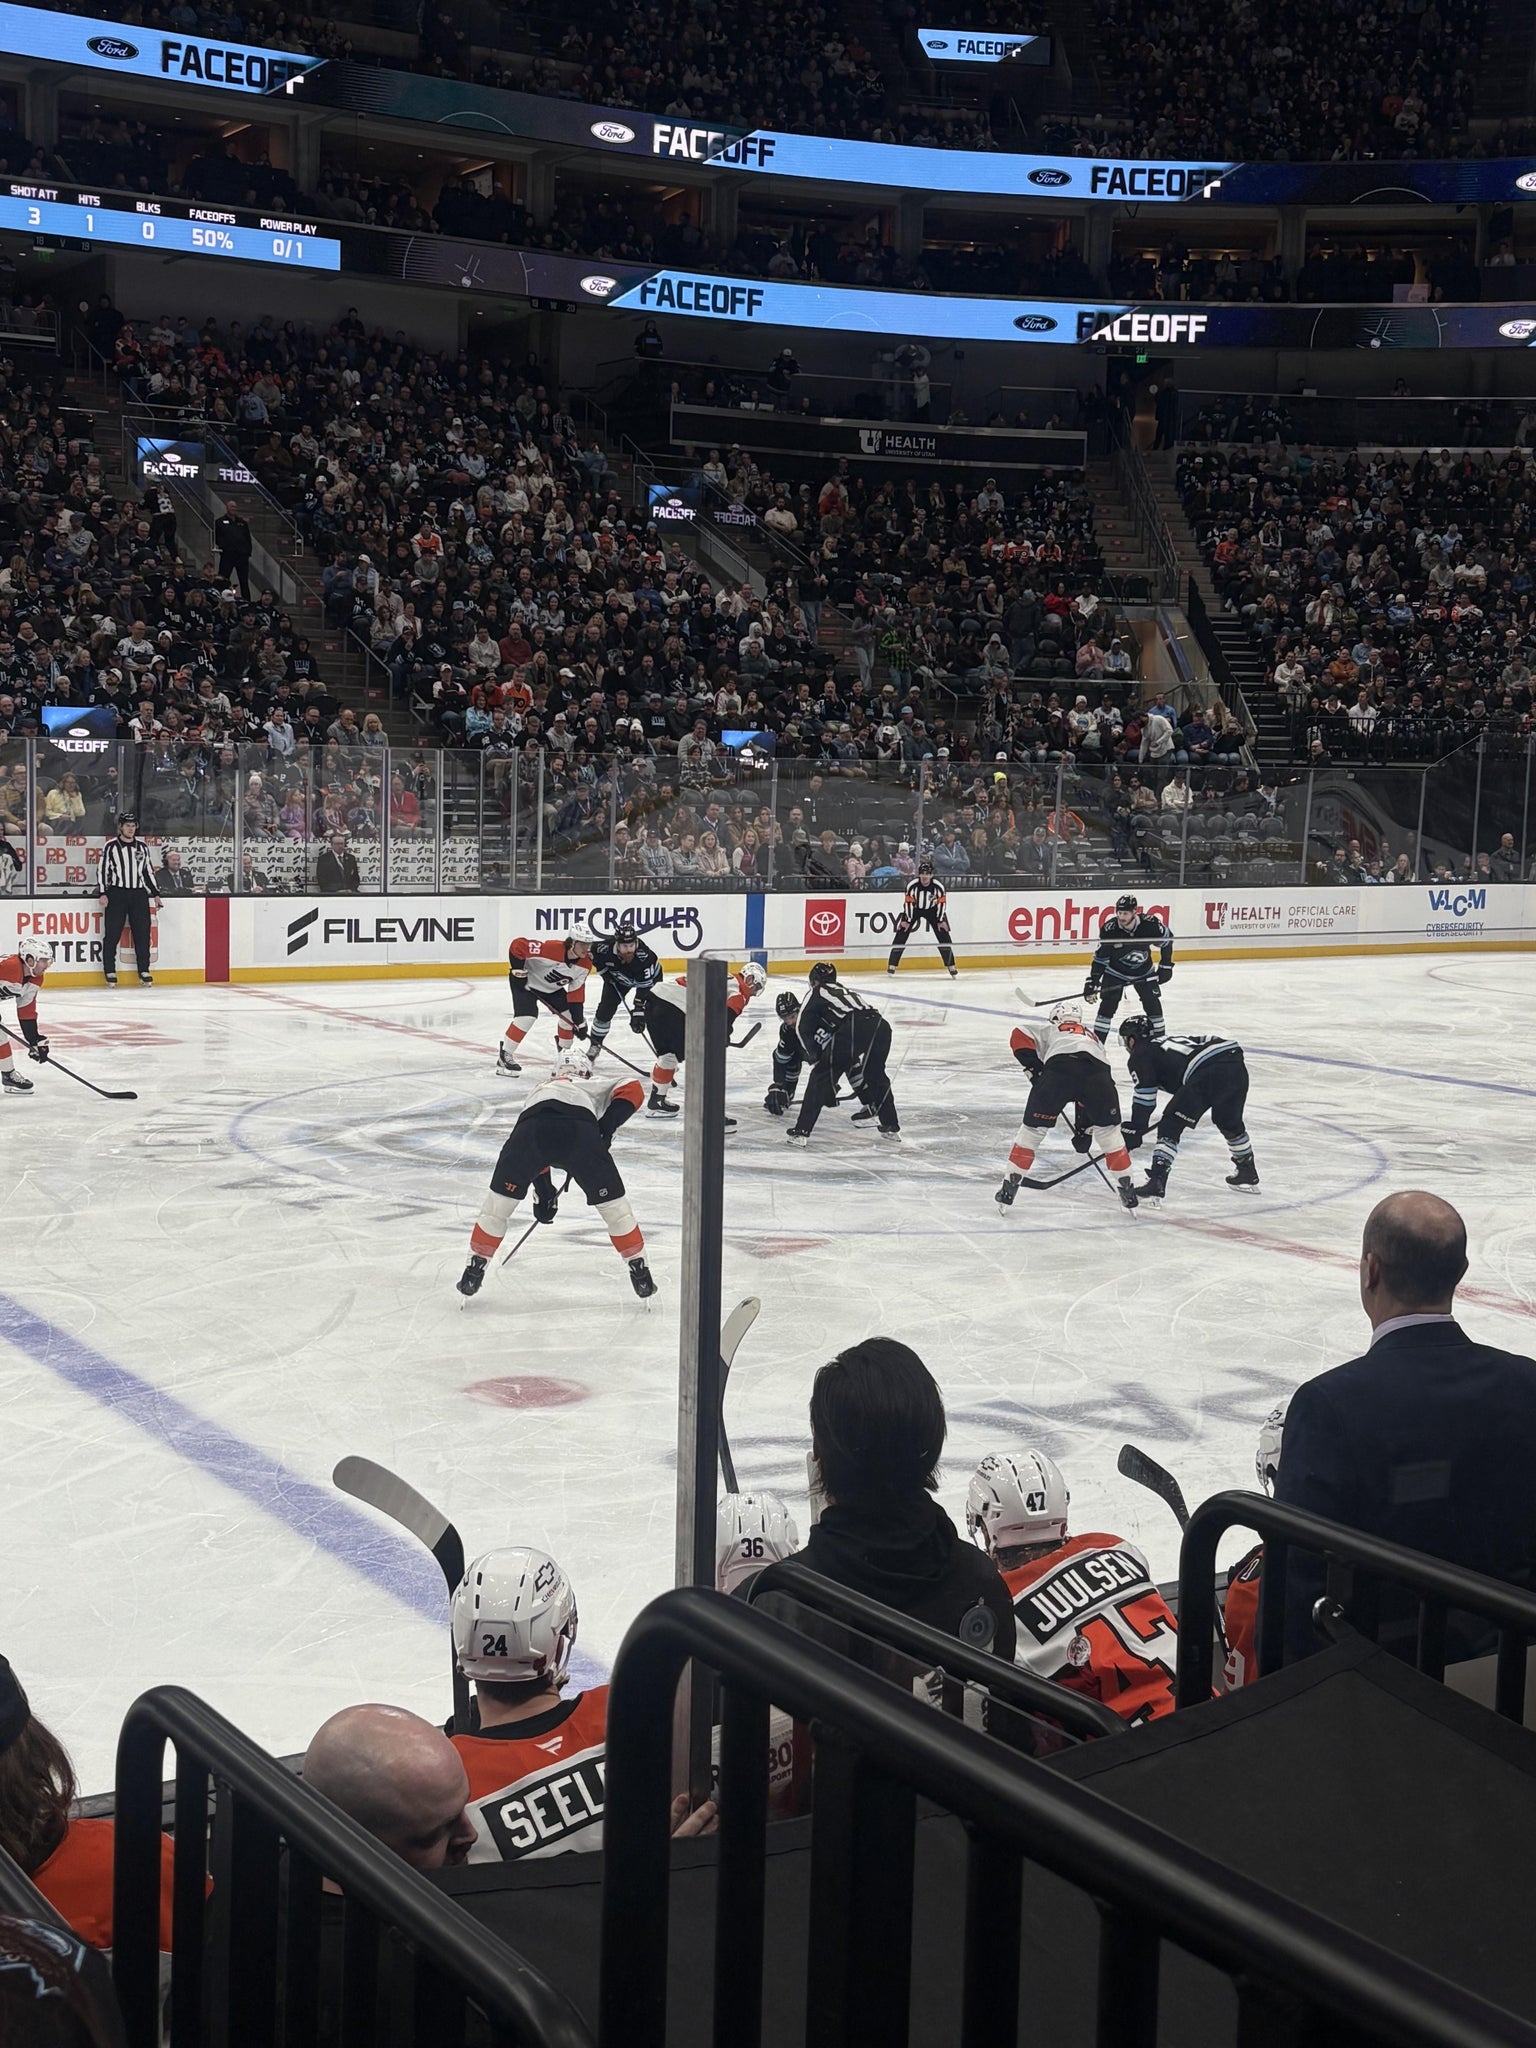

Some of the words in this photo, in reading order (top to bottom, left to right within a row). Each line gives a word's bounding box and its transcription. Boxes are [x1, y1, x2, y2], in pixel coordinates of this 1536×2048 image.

[957, 39, 1022, 57] FACEOFF
[94, 37, 133, 58] Ford
[161, 40, 306, 94] FACEOFF
[596, 122, 629, 142] Ford
[653, 123, 776, 167] FACEOFF
[1032, 169, 1067, 186] Ford
[1091, 166, 1223, 198] FACEOFF
[11, 185, 37, 198] SHOT
[38, 188, 58, 201] ATT
[78, 194, 100, 206] HITS
[28, 207, 41, 225] 3
[136, 202, 161, 215] BLKS
[189, 209, 236, 225] FACEOFFS
[86, 215, 94, 232] 1
[142, 222, 155, 239] 0
[260, 218, 293, 234] POWER
[293, 222, 317, 236] PLAY
[192, 228, 234, 250] 50%
[273, 239, 303, 259] 0/1
[640, 278, 764, 316] FACEOFF
[1018, 314, 1053, 332] Ford
[1076, 311, 1208, 342] FACEOFF
[885, 435, 936, 450] HEALTH
[653, 506, 696, 520] FACEOFF
[1231, 907, 1281, 920] HEALTH
[1288, 906, 1329, 917] OFFICIAL
[1332, 905, 1357, 915] CARE
[17, 912, 104, 935] PEANUT
[324, 917, 475, 943] FILEVINE
[855, 912, 951, 934] TOY
[1288, 918, 1334, 928] PROVIDER
[19, 941, 103, 963] TTER
[813, 1027, 829, 1045] 22
[1026, 1491, 1047, 1512] 47
[741, 1537, 764, 1558] 36
[1030, 1551, 1145, 1633] JUULSEN
[482, 1634, 508, 1657] 24
[500, 1761, 606, 1848] SEEL
